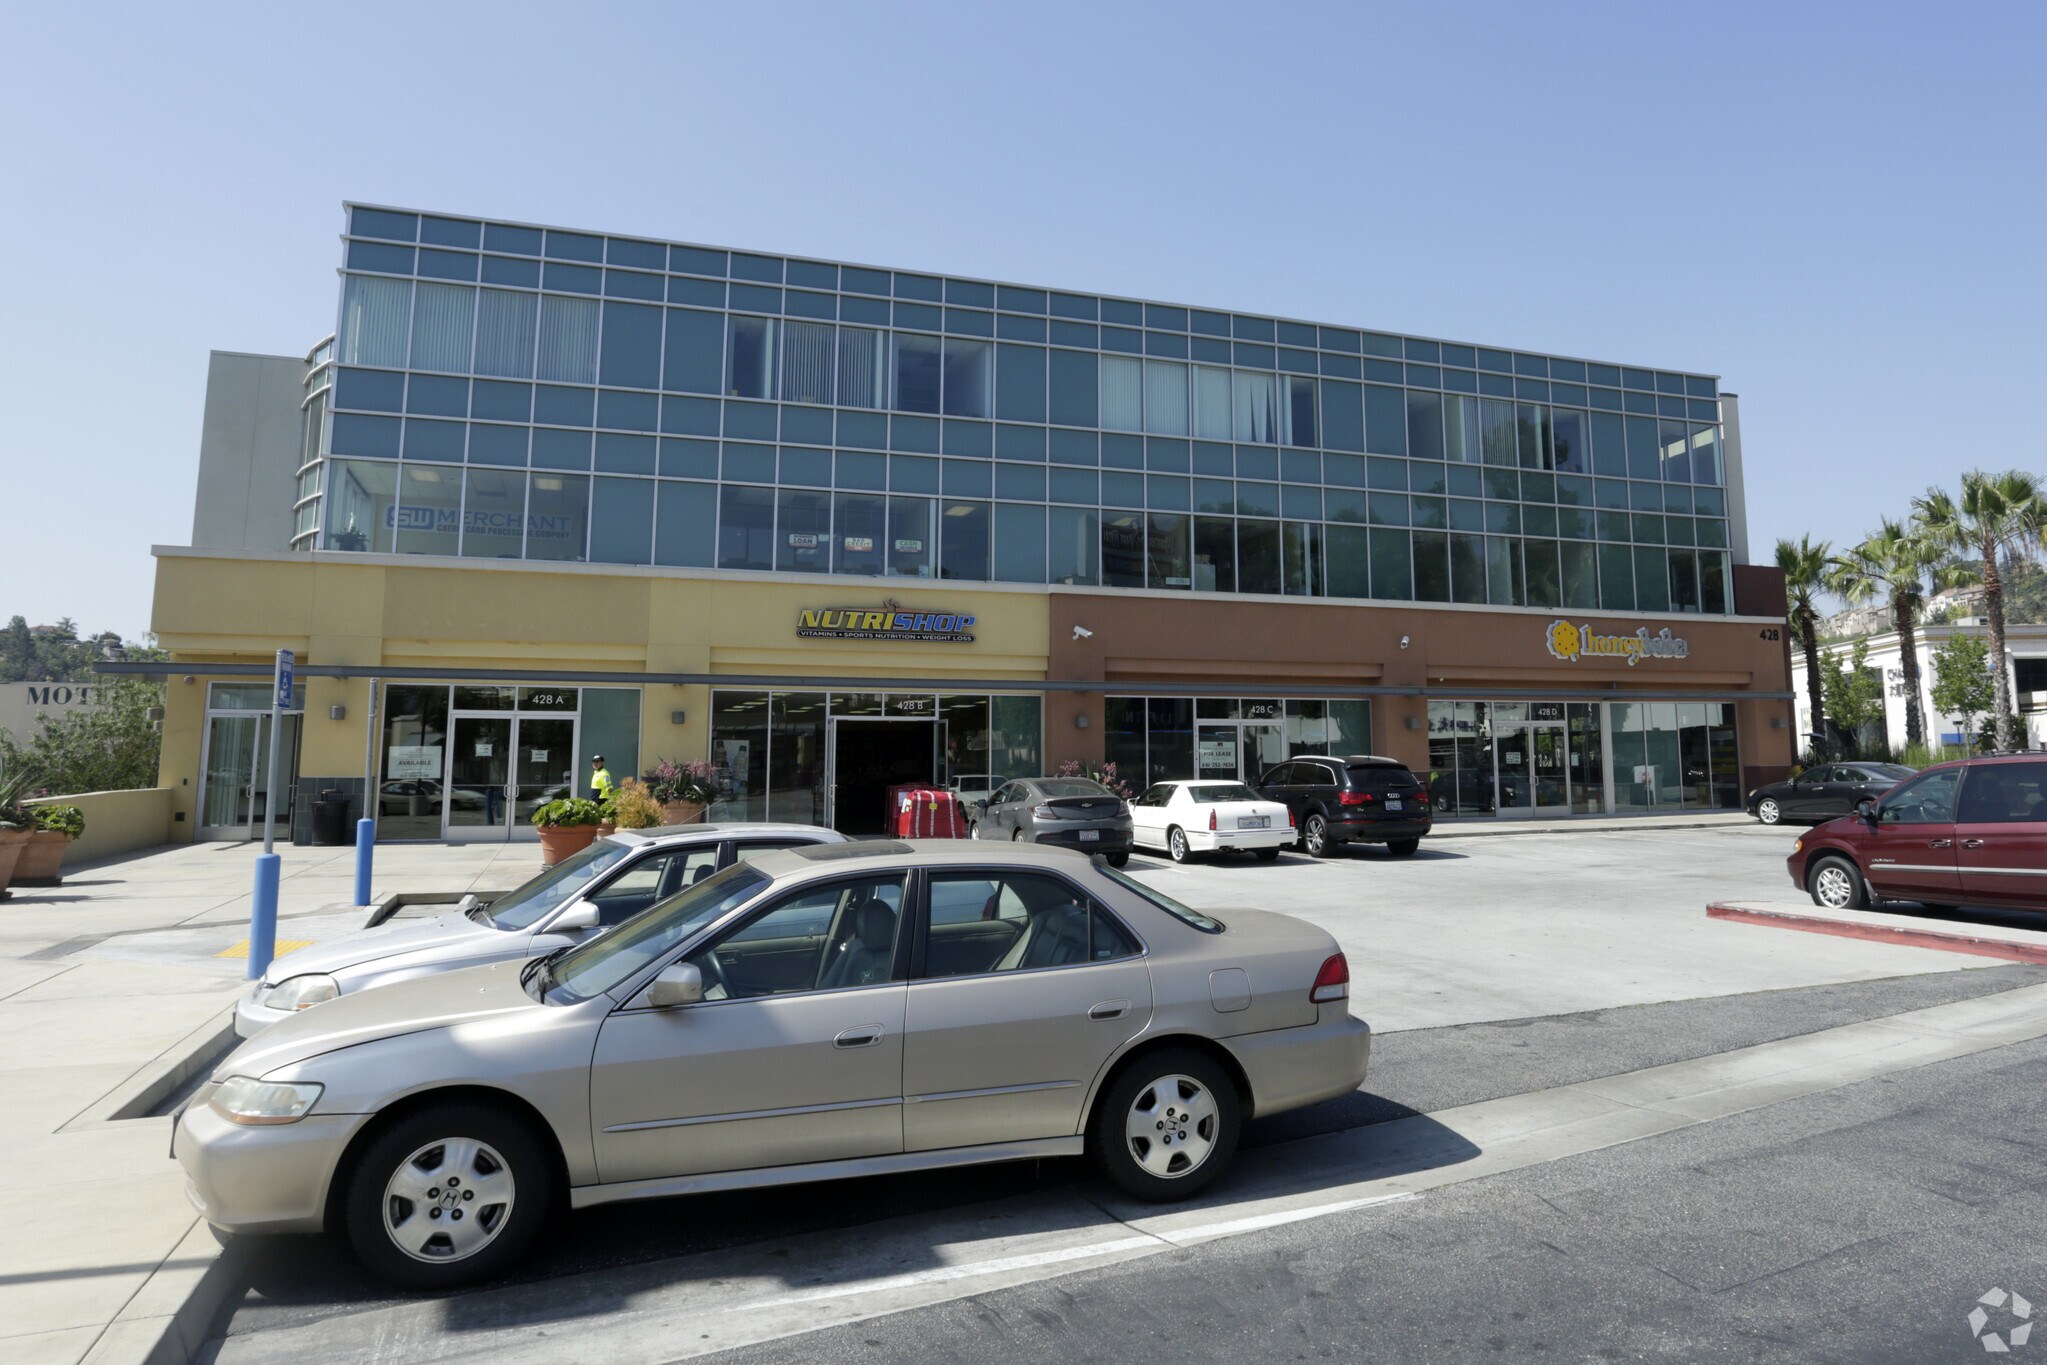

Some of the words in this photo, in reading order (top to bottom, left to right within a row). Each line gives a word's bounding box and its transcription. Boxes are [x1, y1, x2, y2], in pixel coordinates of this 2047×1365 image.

[437, 509, 571, 530] MERCHANT
[437, 524, 460, 533] CREDI
[465, 526, 486, 535] CARD
[487, 527, 534, 539] PROCESSIG
[535, 530, 570, 540] COMPANY
[797, 609, 976, 632] NUTRISHOP
[1759, 628, 1779, 641] 428
[532, 694, 553, 704] 428
[555, 695, 564, 704] A
[897, 701, 915, 710] 428
[917, 701, 923, 710] B
[1250, 705, 1266, 714] 428
[1267, 705, 1274, 714] C
[1538, 708, 1551, 716] 428
[1552, 708, 1558, 716] D
